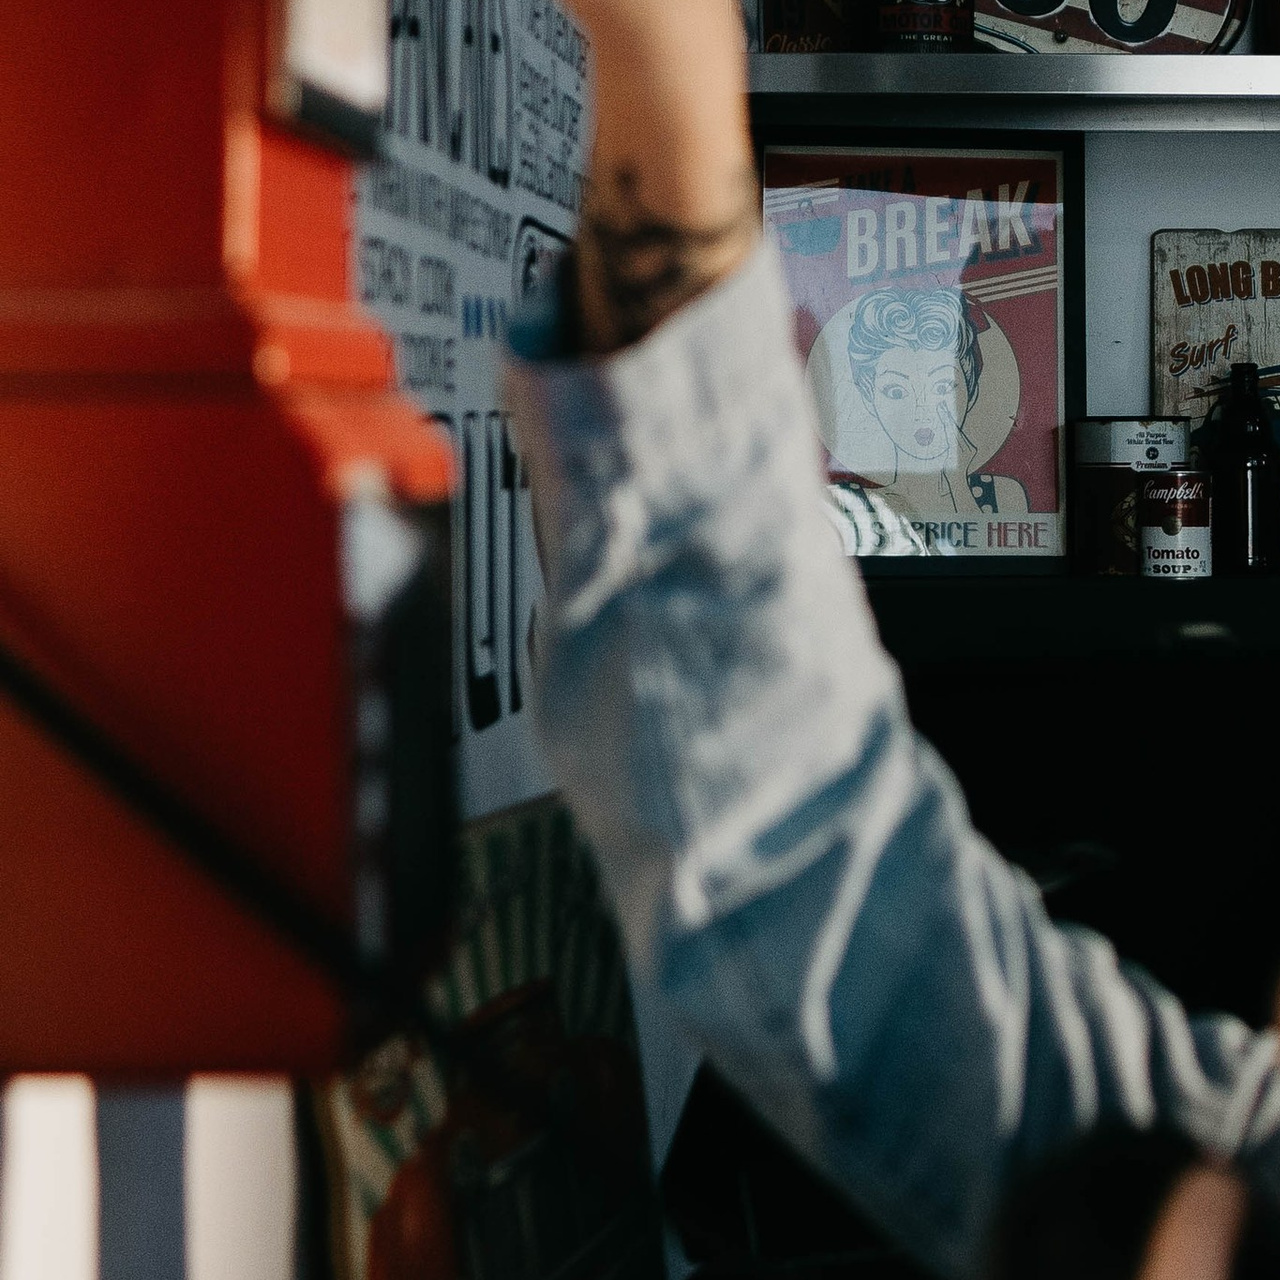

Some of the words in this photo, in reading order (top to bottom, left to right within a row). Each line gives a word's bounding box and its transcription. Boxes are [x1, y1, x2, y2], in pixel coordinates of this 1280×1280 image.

[847, 180, 1034, 280] BREAK
[1169, 261, 1256, 309] LONG
[1168, 324, 1238, 377] Surf
[987, 521, 1049, 548] HERE
[1146, 546, 1200, 560] Tomato
[1152, 564, 1192, 574] SOUP
